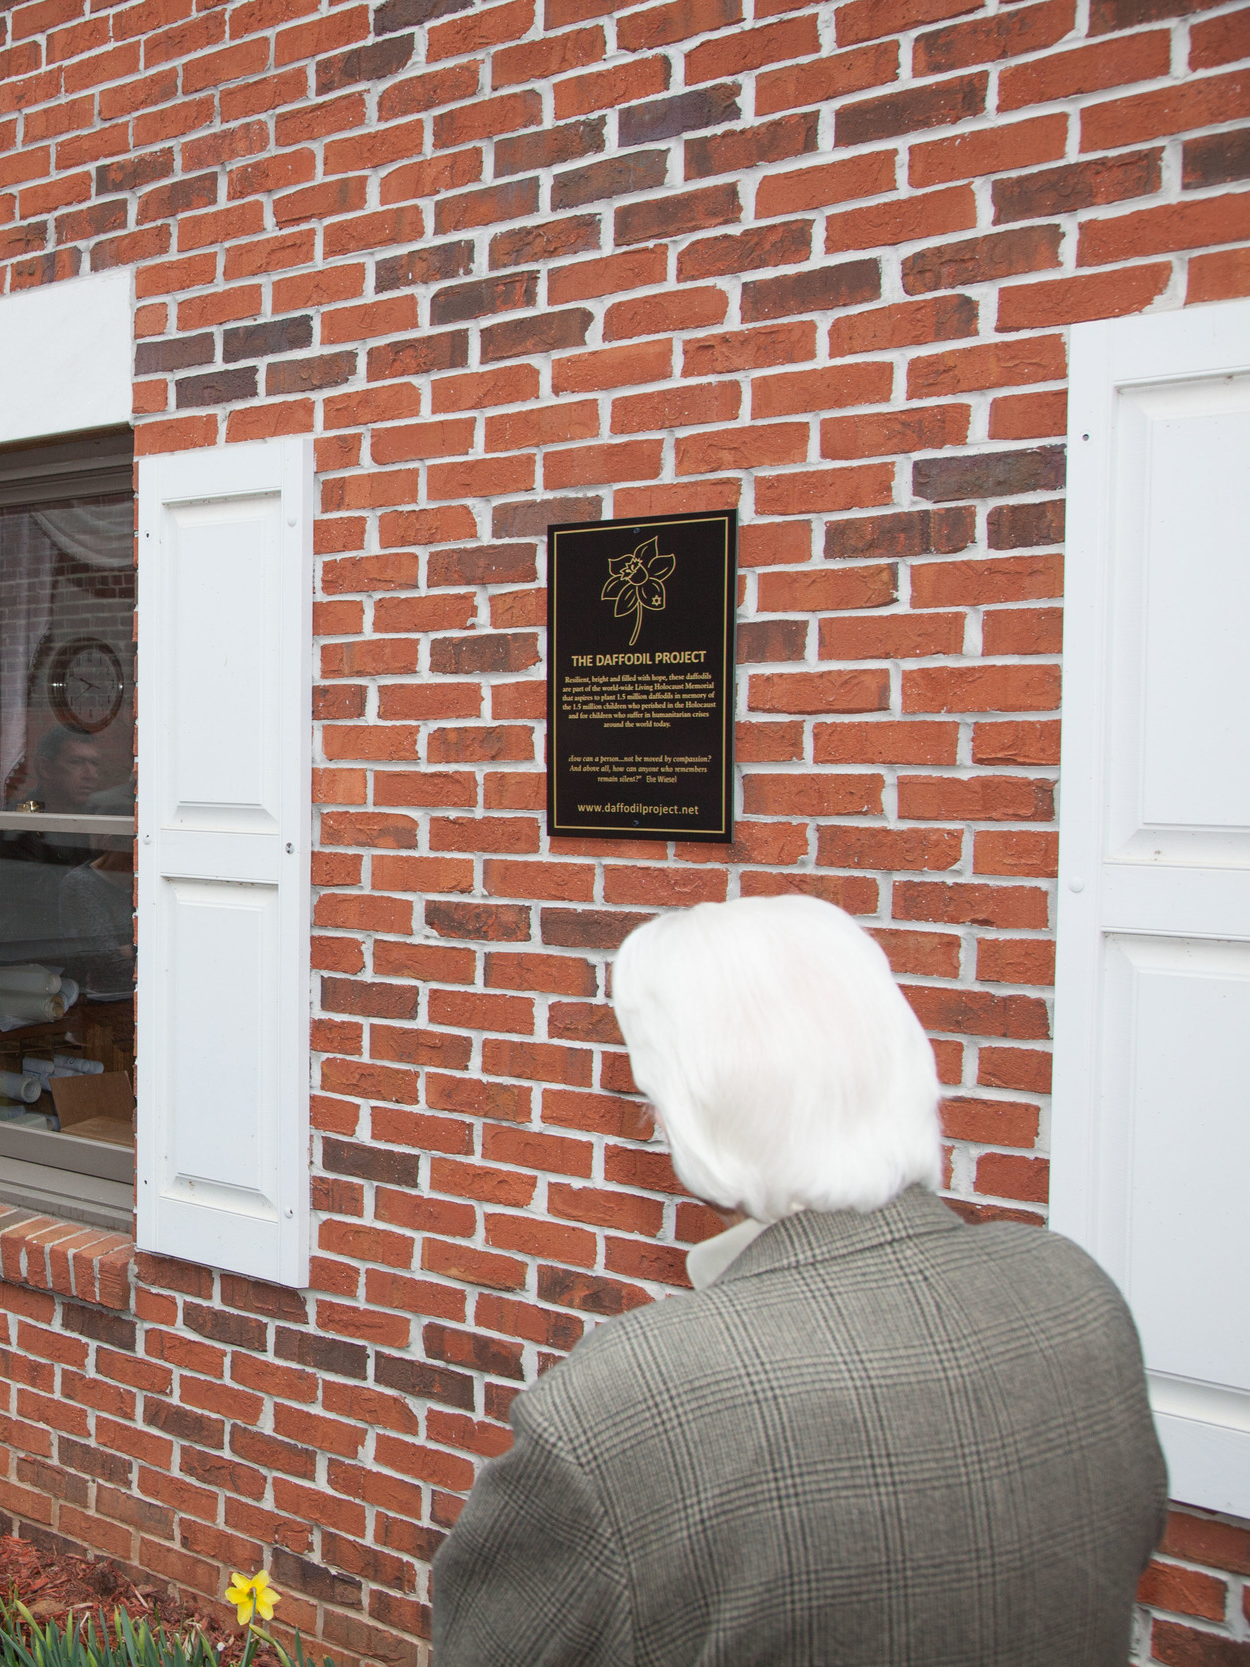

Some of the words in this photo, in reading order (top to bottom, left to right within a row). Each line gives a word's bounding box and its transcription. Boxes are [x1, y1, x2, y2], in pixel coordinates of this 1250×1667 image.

[571, 655, 593, 667] THE
[596, 653, 652, 666] DAFFODIL
[655, 650, 707, 664] PROJECT
[565, 676, 591, 684] Resilient,
[592, 675, 609, 684] bright
[652, 674, 668, 682] hope,
[686, 672, 712, 680] daffodils
[635, 684, 654, 692] Living
[601, 694, 616, 702] plant
[641, 702, 666, 710] perished
[654, 720, 671, 728] today.
[664, 754, 672, 764] by
[672, 754, 712, 764] compassion?
[600, 764, 611, 773] all,
[660, 764, 674, 772] who
[658, 775, 678, 783] Wiesel
[577, 802, 699, 816] www.daffodilproject.net
